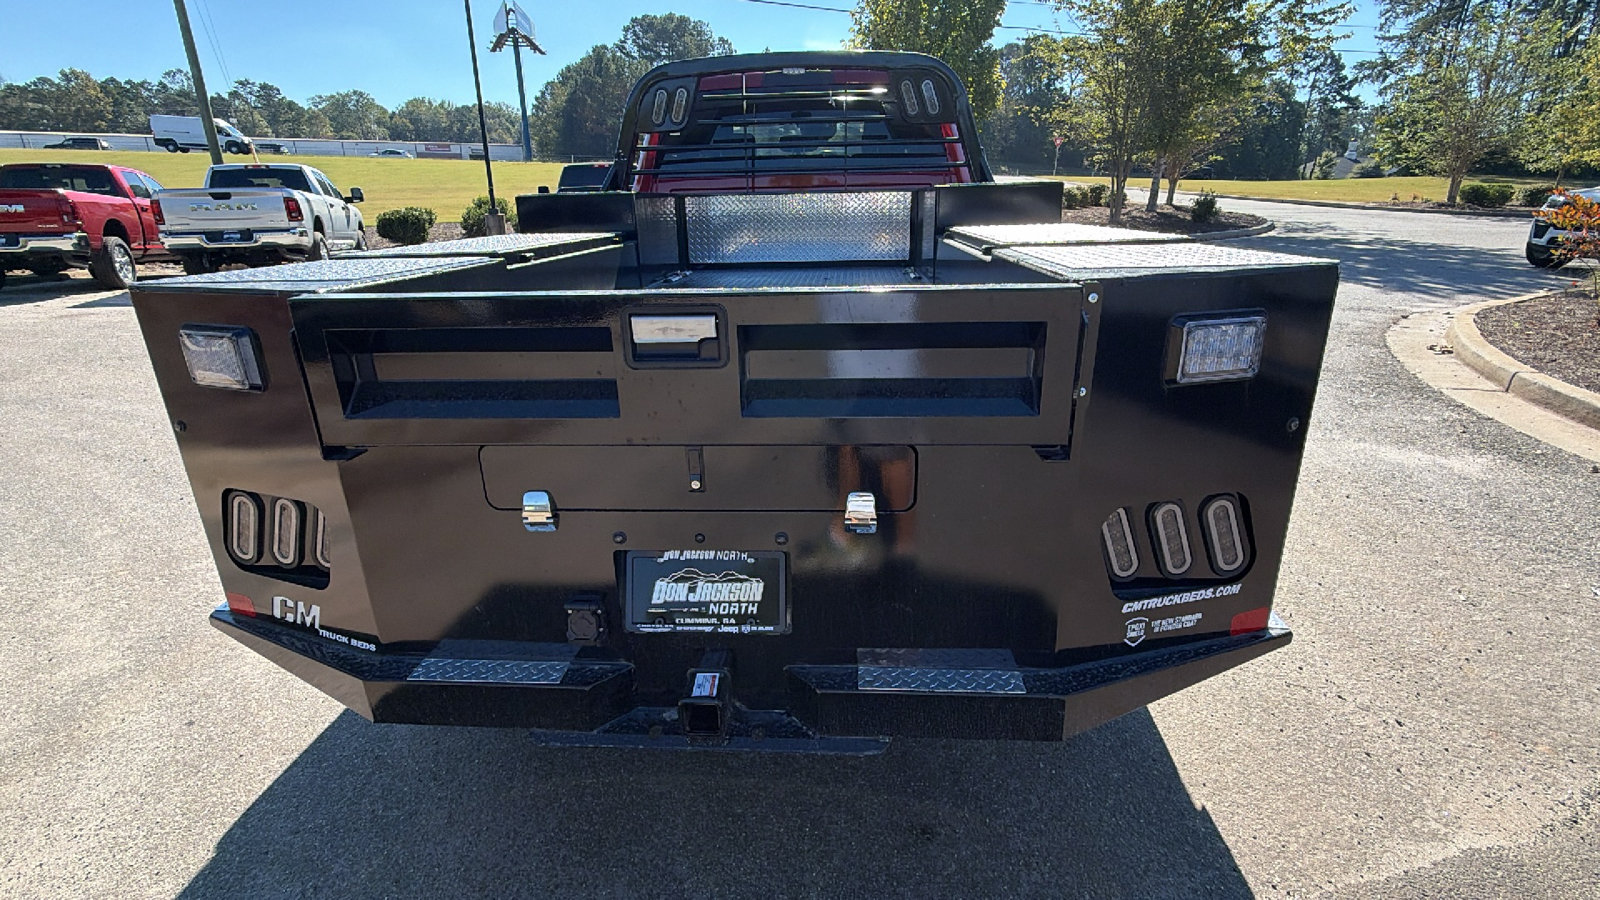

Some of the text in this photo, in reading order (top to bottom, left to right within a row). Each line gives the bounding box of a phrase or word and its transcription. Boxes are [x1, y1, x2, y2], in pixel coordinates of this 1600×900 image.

[663, 550, 748, 561] DON JACKSON NORTH
[651, 580, 764, 604] DON JACKSON
[1122, 584, 1242, 613] CMTRUCKBEDS.COM
[272, 596, 320, 631] CM
[708, 603, 758, 614] NORTH
[718, 625, 739, 633] Jeep
[1162, 617, 1174, 626] NEW
[319, 628, 377, 652] TRUCK BEDS
